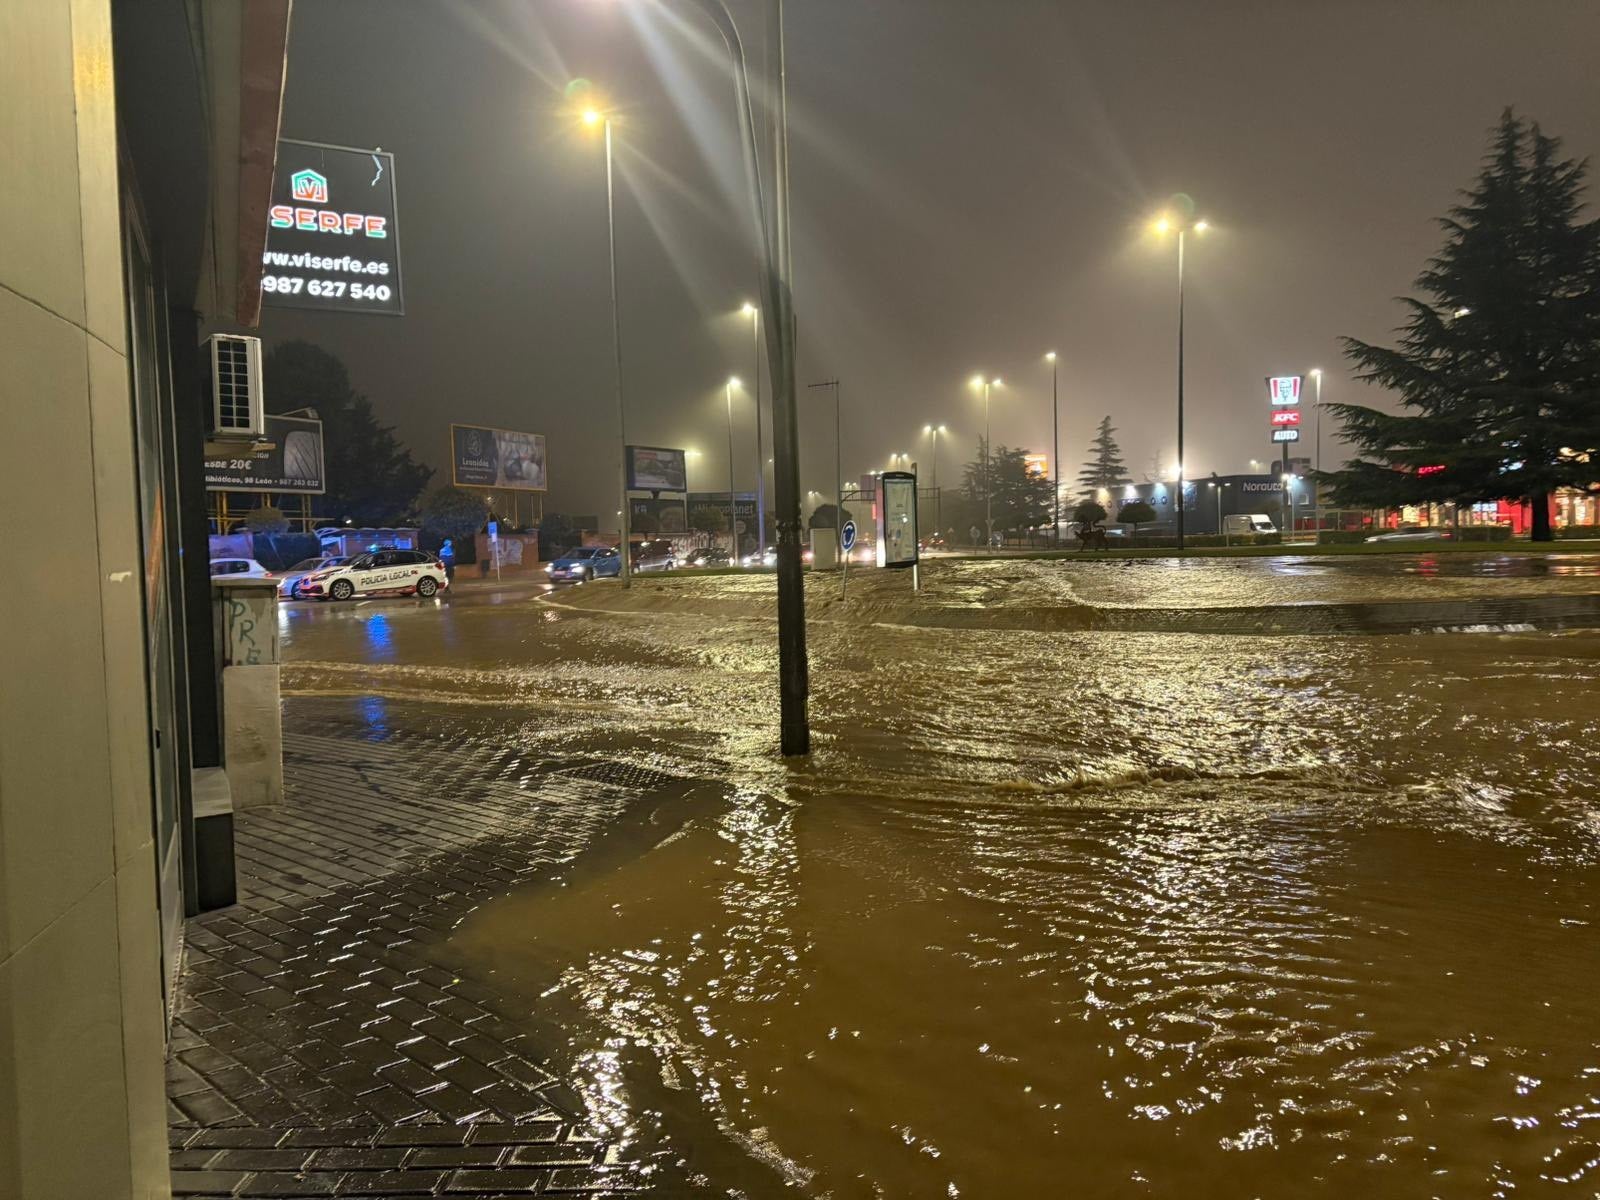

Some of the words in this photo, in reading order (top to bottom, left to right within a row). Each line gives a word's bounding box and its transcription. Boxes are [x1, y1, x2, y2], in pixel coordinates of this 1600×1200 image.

[271, 205, 387, 238] SERFE
[263, 276, 304, 294] 987
[307, 279, 346, 297] 627
[350, 283, 391, 301] 540
[1273, 413, 1299, 422] KFC
[1273, 430, 1298, 440] AUTO
[230, 459, 253, 470] 20€
[1242, 481, 1283, 492] Norauto
[389, 570, 411, 581] LOCAL
